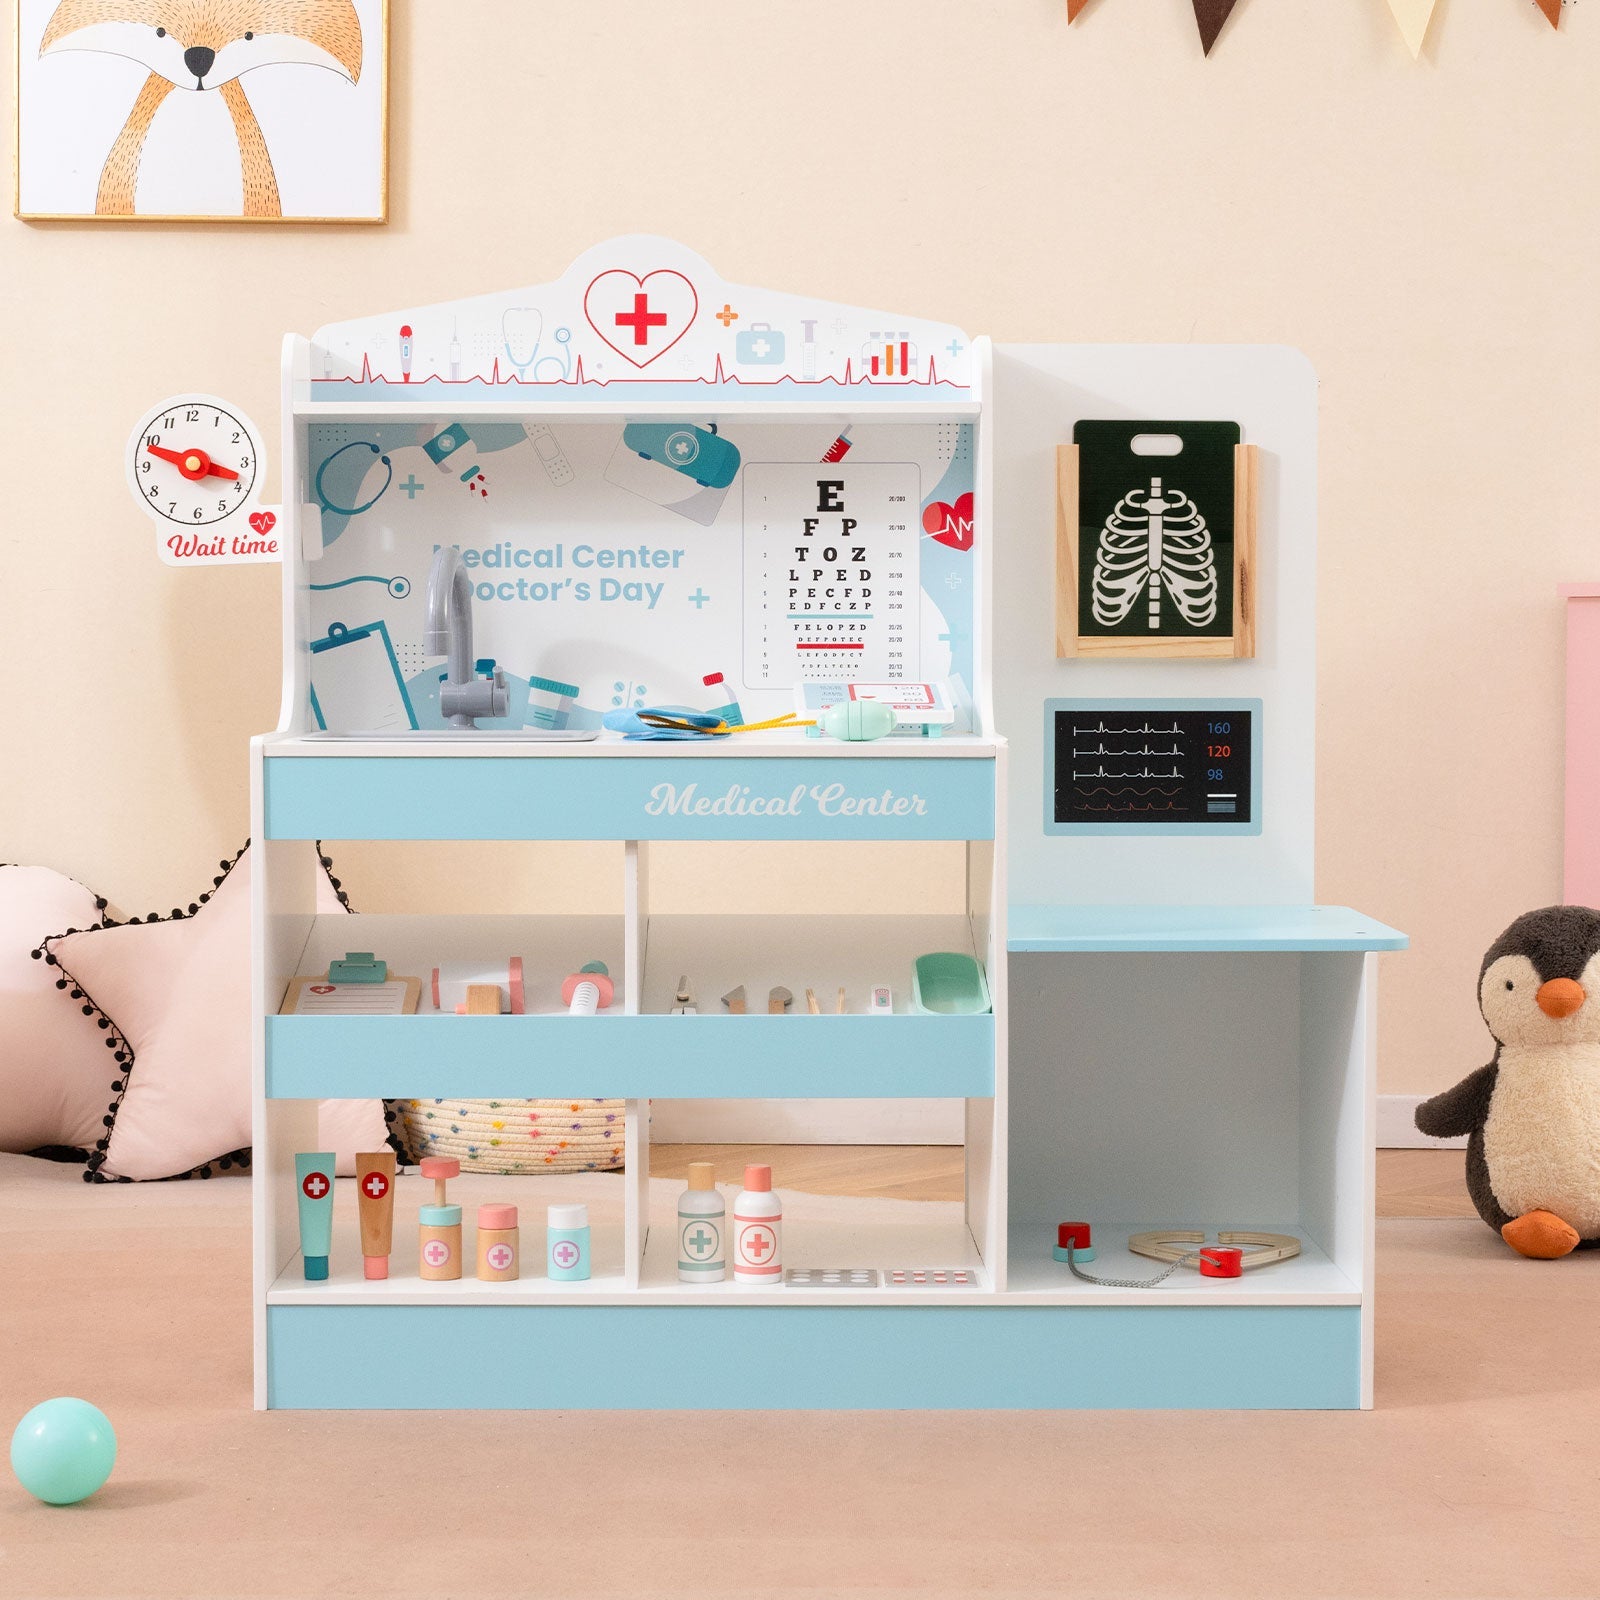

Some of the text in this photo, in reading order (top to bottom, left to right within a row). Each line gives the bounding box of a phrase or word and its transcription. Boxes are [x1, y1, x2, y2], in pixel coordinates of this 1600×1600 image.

[186, 410, 199, 422] 12
[214, 416, 220, 427] 1
[163, 416, 175, 429] 11
[146, 434, 161, 446] 10
[231, 432, 240, 444] 2
[142, 461, 151, 474] 9
[240, 457, 249, 469] 3
[150, 485, 159, 497] 8
[234, 481, 242, 493] 4
[817, 481, 844, 512] E
[168, 502, 177, 514] 7
[218, 500, 226, 512] 5
[193, 507, 203, 519] 6
[804, 519, 819, 536] F
[842, 519, 857, 536] P
[167, 534, 279, 557] Wait time
[433, 542, 685, 569] edical Center
[795, 548, 808, 561] T
[823, 547, 837, 561] O
[852, 548, 865, 561] Z
[600, 578, 664, 610] Day
[1207, 722, 1231, 734] 160
[1207, 745, 1231, 758] 120
[1207, 768, 1223, 781] 98
[644, 783, 928, 816] Medical Center
